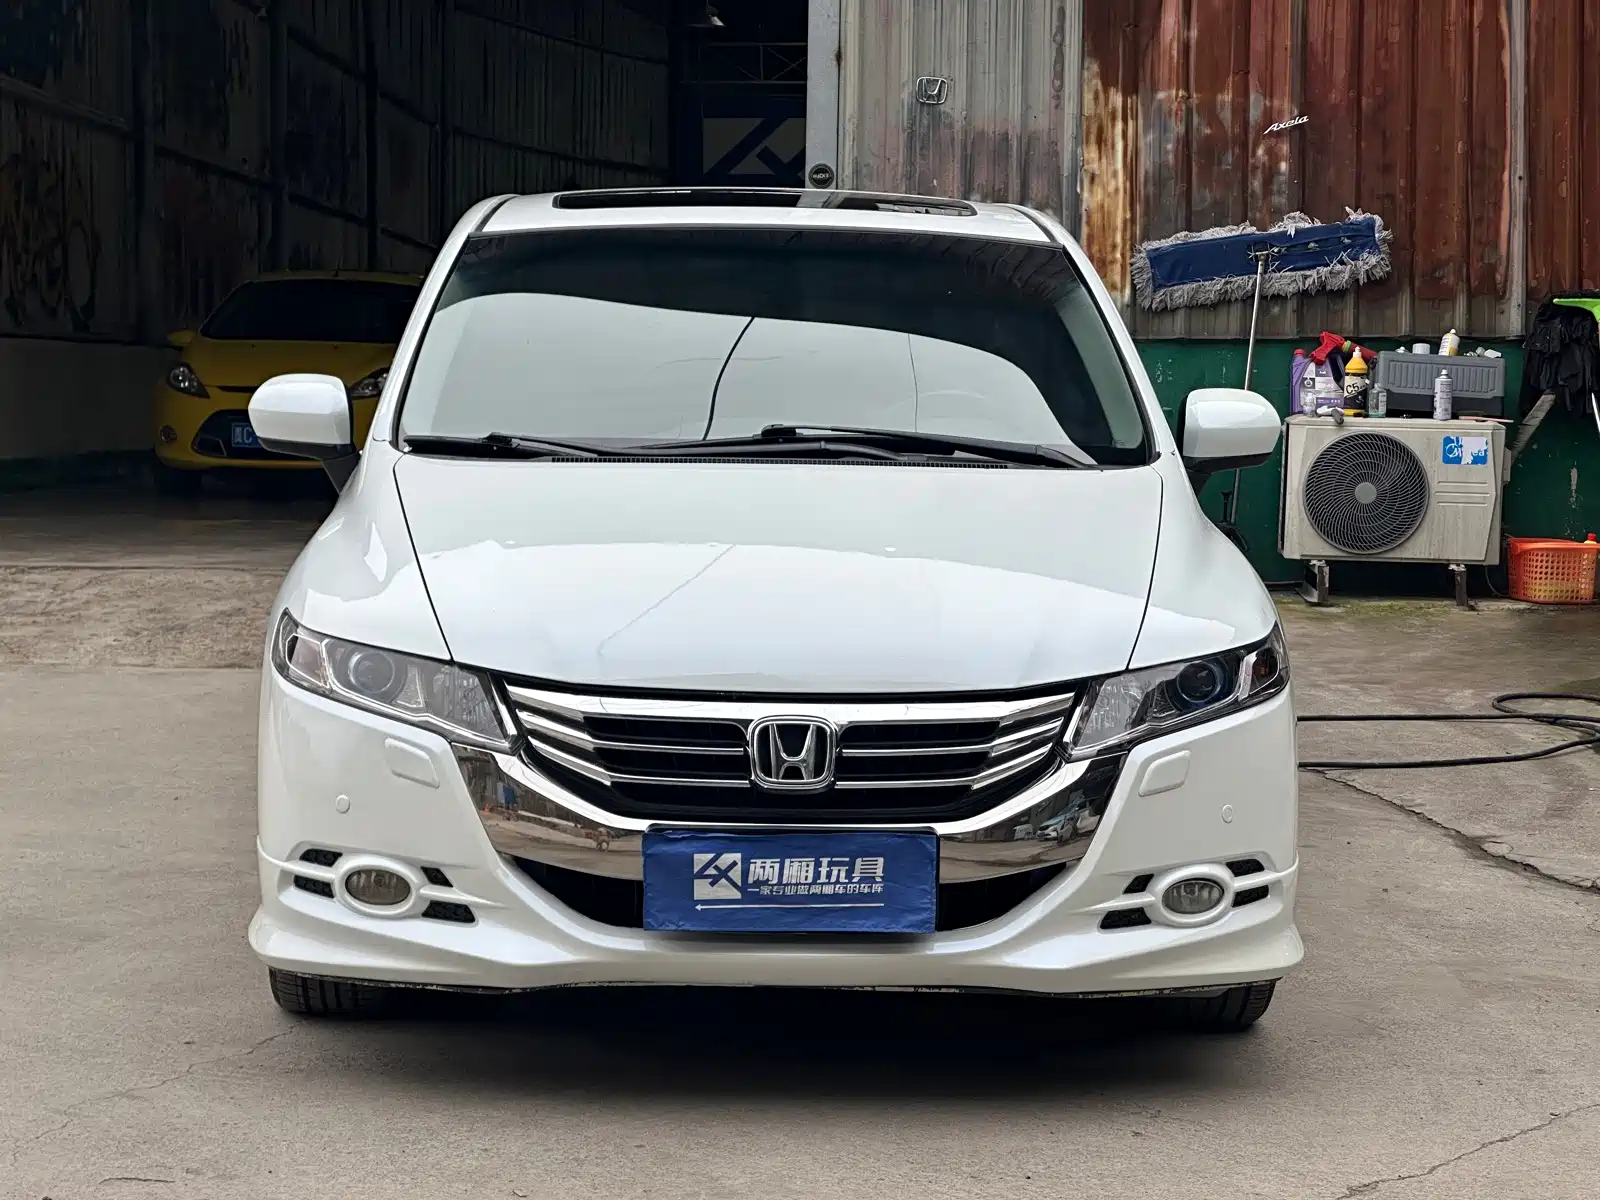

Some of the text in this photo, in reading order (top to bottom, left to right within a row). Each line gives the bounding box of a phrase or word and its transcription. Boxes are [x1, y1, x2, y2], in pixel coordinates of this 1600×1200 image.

[1263, 115, 1309, 135] Axela
[747, 857, 884, 884] 两厢玩具
